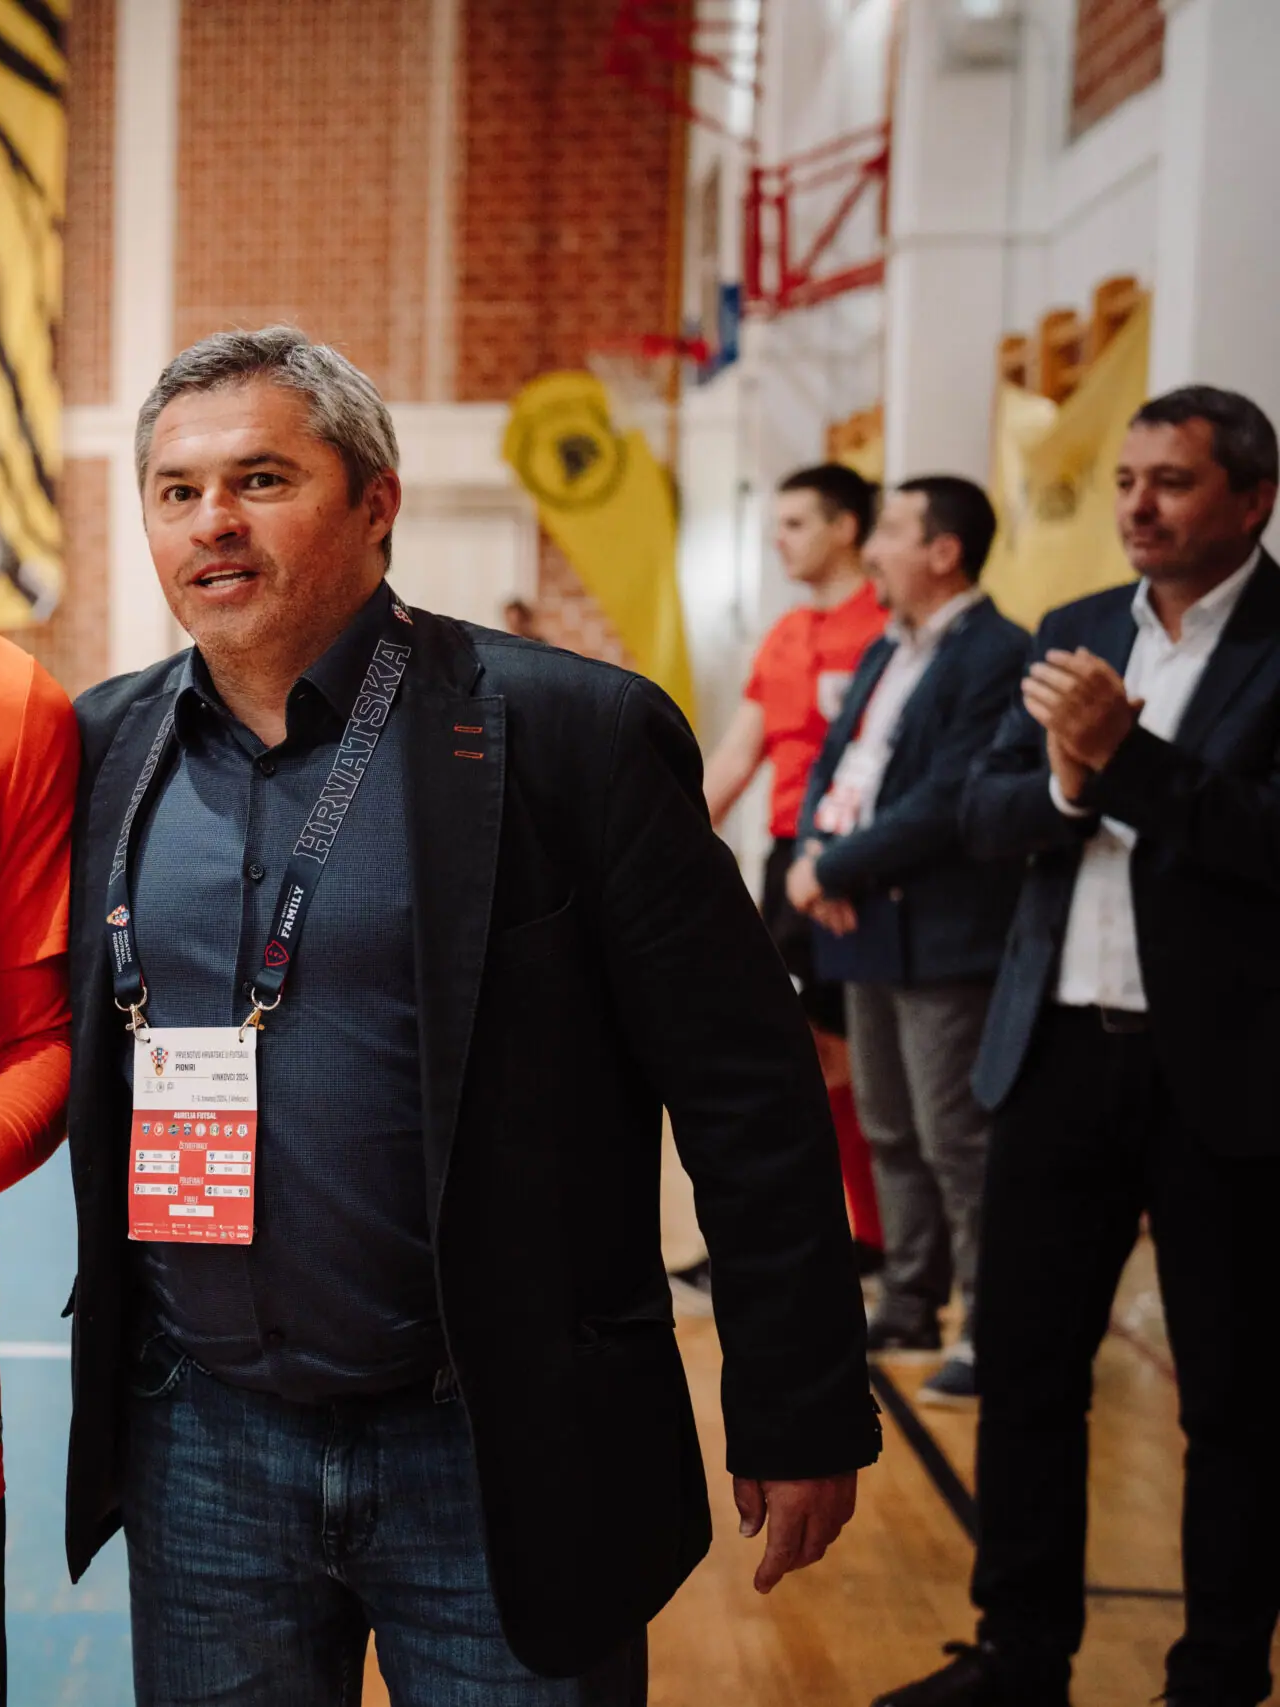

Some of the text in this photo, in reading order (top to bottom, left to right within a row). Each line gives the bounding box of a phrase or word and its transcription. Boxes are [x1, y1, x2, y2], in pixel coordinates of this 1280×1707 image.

[293, 639, 411, 865] HRVATSKA
[281, 885, 305, 939] FAMILY
[112, 932, 122, 973] FEDERATION
[117, 930, 127, 965] FOOTBALL
[123, 929, 132, 963] CROATIAN
[175, 1063, 196, 1072] PIONIRI
[212, 1073, 236, 1081] VINKOVCI
[173, 1111, 217, 1120] AURELIA FUTSAL
